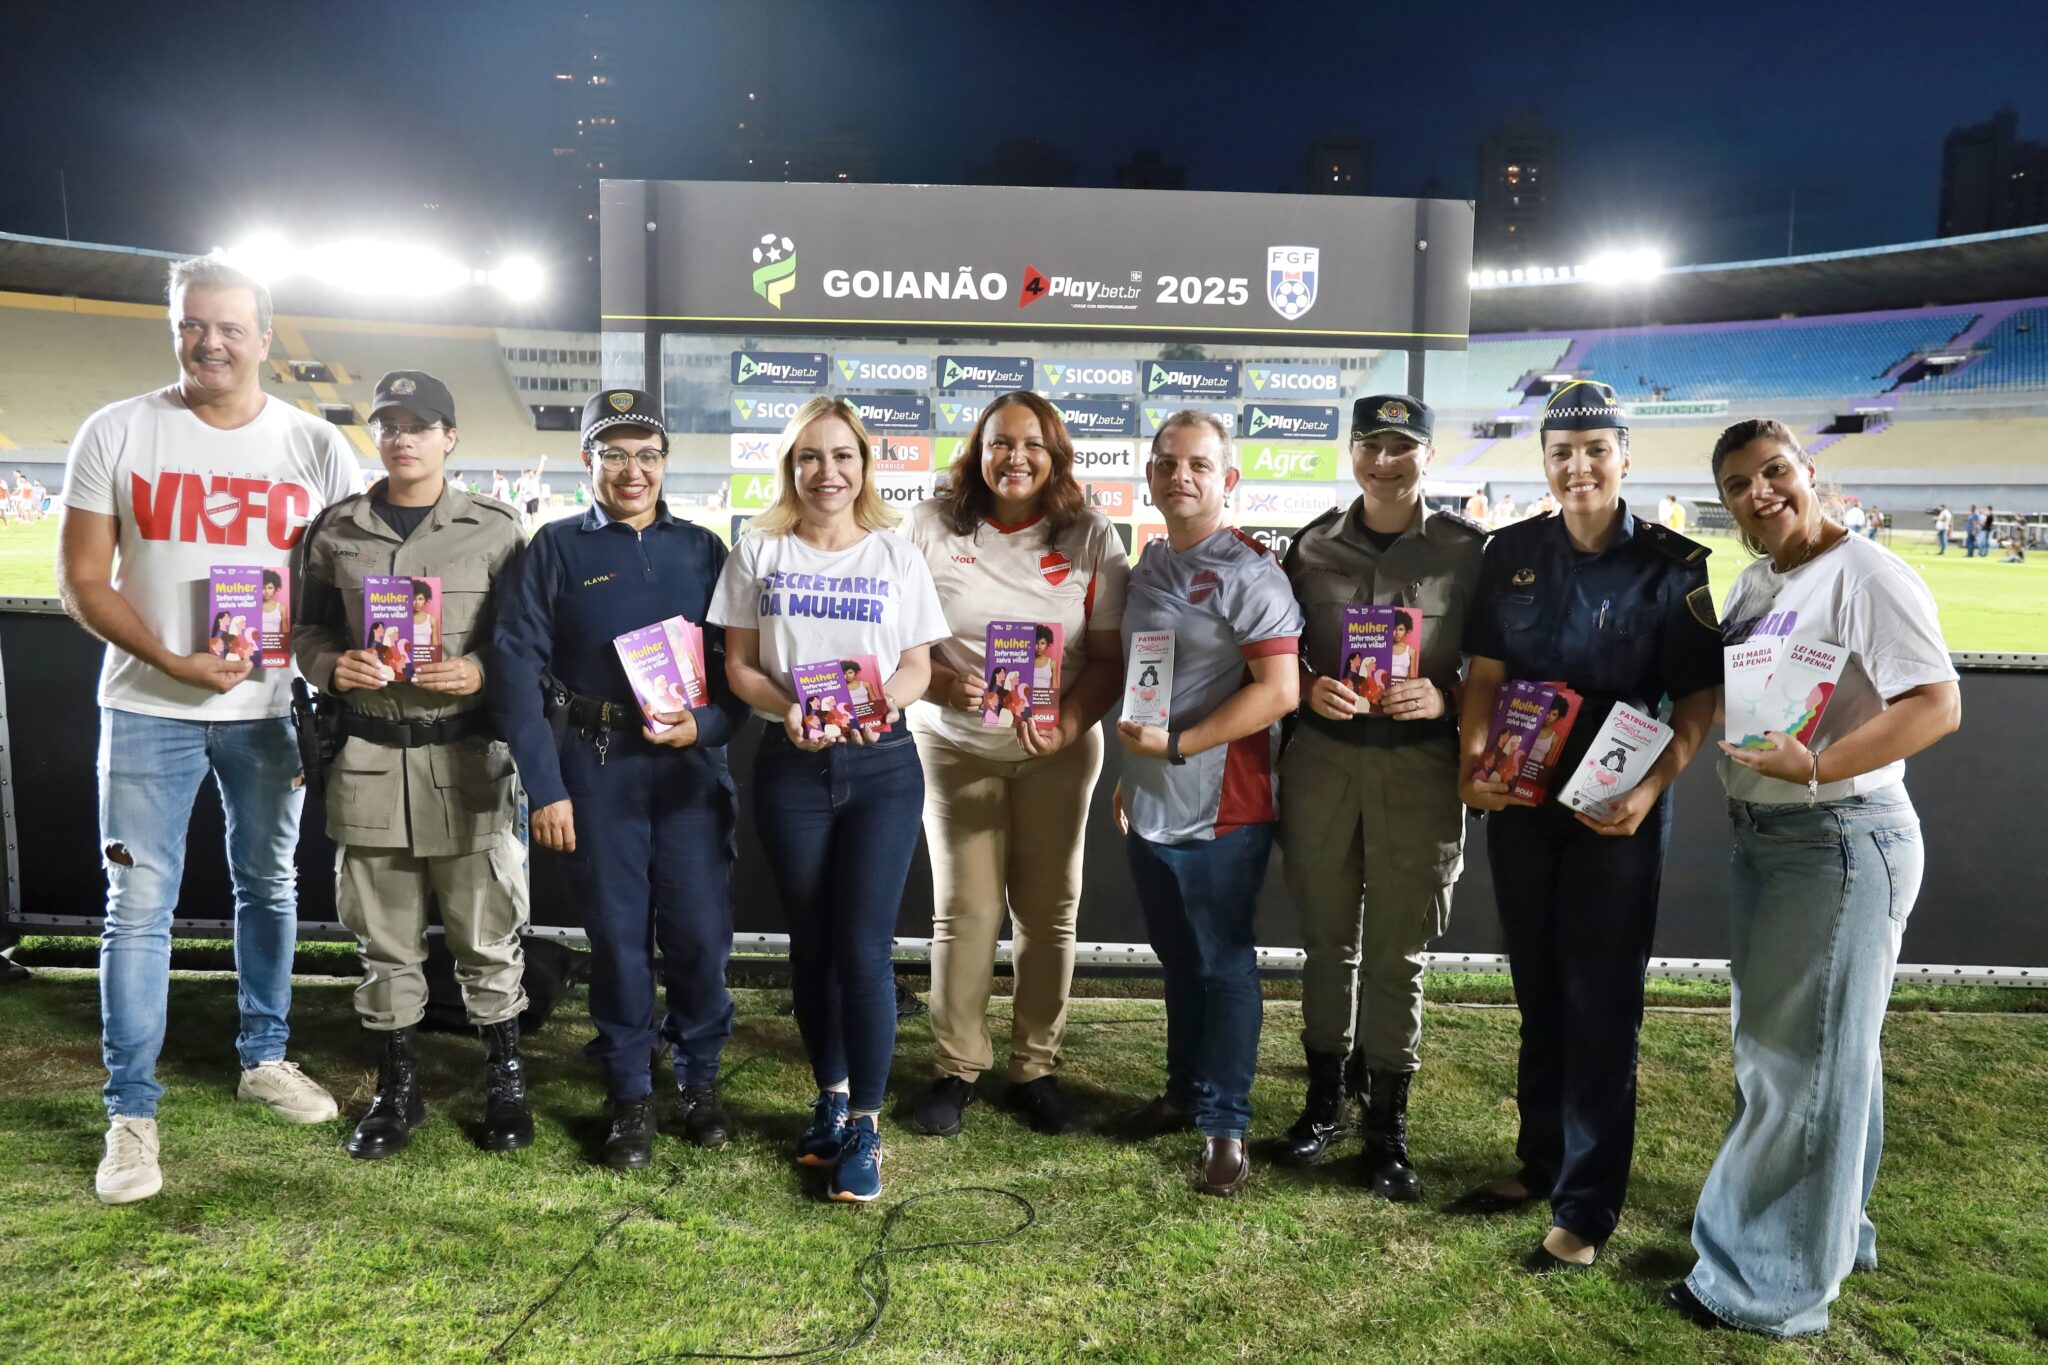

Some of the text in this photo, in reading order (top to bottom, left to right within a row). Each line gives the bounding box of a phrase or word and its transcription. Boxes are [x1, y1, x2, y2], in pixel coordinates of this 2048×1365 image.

[1272, 252, 1315, 264] FGF
[823, 266, 1008, 301] GOIANÃO
[1156, 276, 1248, 305] 2025
[860, 363, 927, 380] SICOOB
[1065, 368, 1133, 385] SICOOB
[1270, 373, 1337, 390] SICOOB
[757, 402, 799, 418] SICO
[859, 405, 920, 422] Play.bet.br
[1064, 410, 1126, 426] Play.bet.br
[1074, 449, 1129, 468] sport
[879, 485, 924, 502] port
[131, 471, 310, 550] VNFC
[1284, 497, 1329, 509] Cristal
[951, 556, 976, 564] VOLT
[584, 576, 609, 587] FLAVIA
[762, 570, 889, 597] SECRETARIA
[760, 593, 884, 624] DA MULHER
[1138, 634, 1169, 642] PATRULHA
[1732, 648, 1772, 661] LEI MARIA
[1746, 656, 1772, 666] PENHA
[1790, 652, 1832, 671] DA PENHA
[1793, 644, 1836, 663] LEI MARIA
[1619, 710, 1658, 733] PATRULHA
